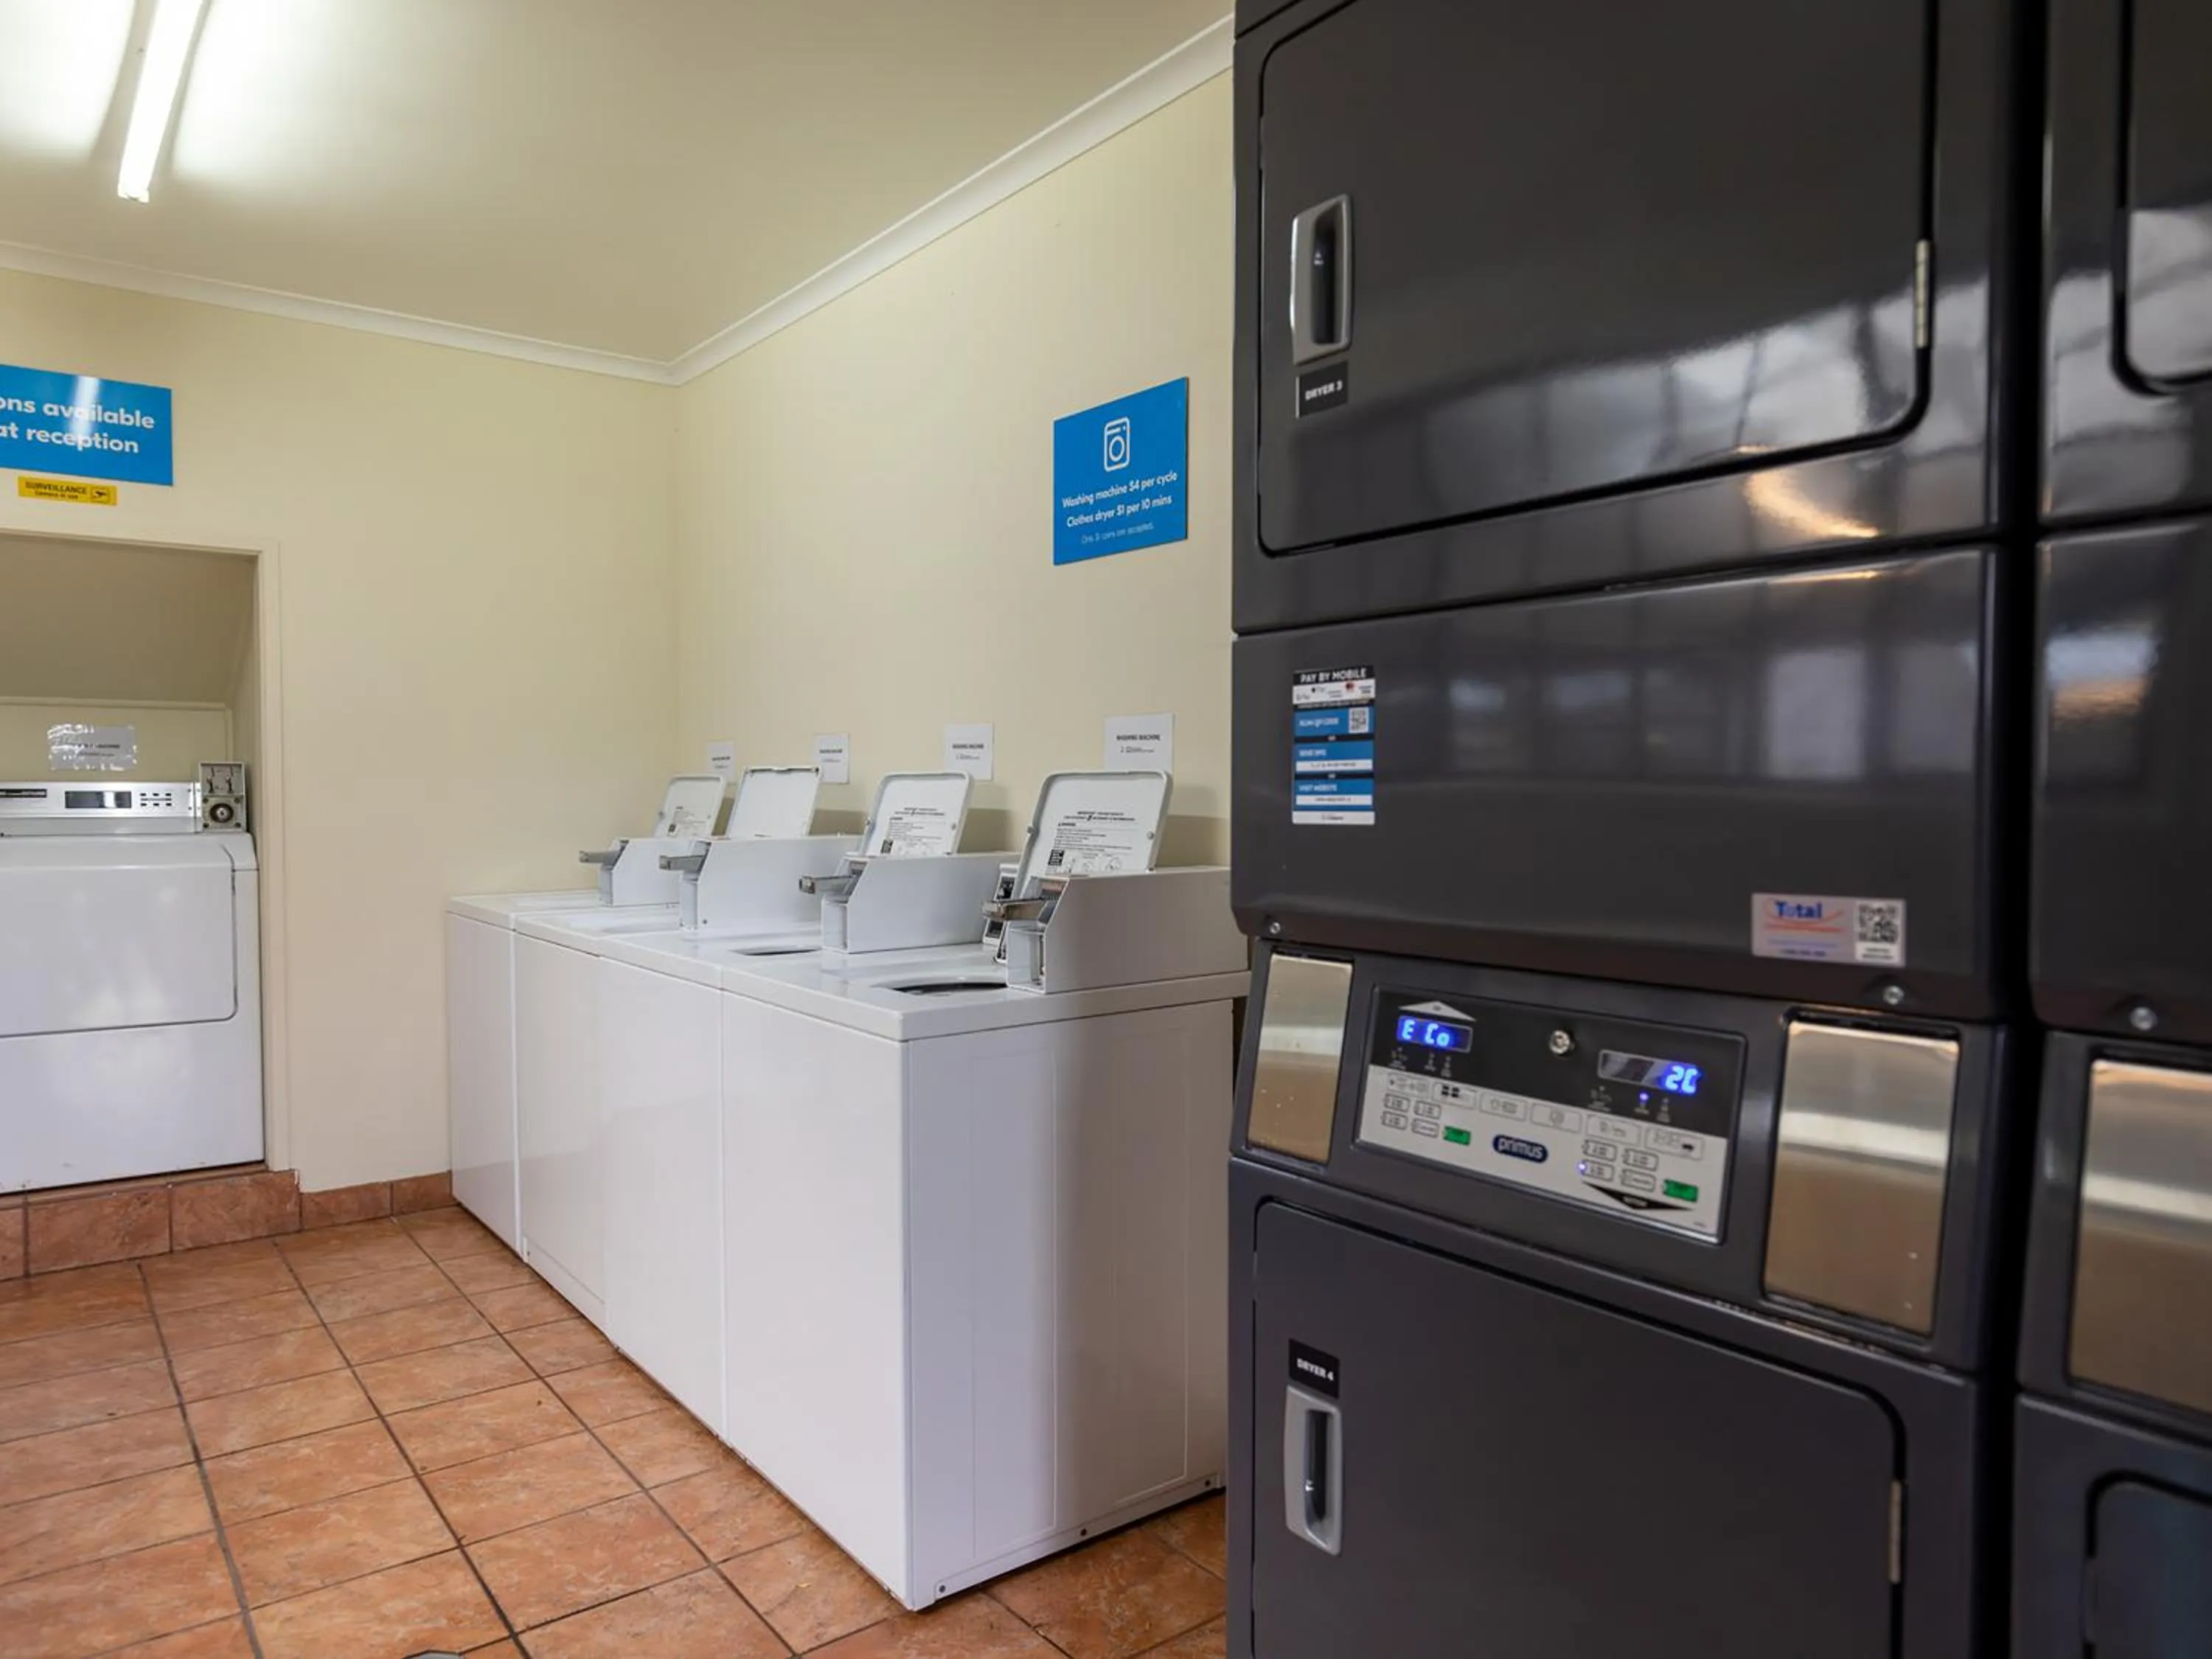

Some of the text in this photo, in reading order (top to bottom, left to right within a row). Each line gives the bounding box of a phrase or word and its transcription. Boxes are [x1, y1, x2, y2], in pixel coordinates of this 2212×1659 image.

[43, 401, 155, 428] available
[27, 427, 139, 453] reception
[25, 481, 87, 494] SURVEILLANCE
[1062, 492, 1094, 507] Washing
[1096, 484, 1127, 499] machine
[1141, 477, 1155, 491] per
[1157, 470, 1178, 487] cycle
[1067, 514, 1093, 527] Clothes
[1095, 509, 1116, 522] dryer
[1126, 502, 1141, 517] per
[1141, 498, 1151, 510] 10
[1152, 495, 1172, 507] mins
[1300, 667, 1367, 684] PAY BY MOBILE
[1775, 900, 1822, 919] Total
[1498, 1137, 1543, 1160] primus
[1297, 1357, 1326, 1379] DRYER
